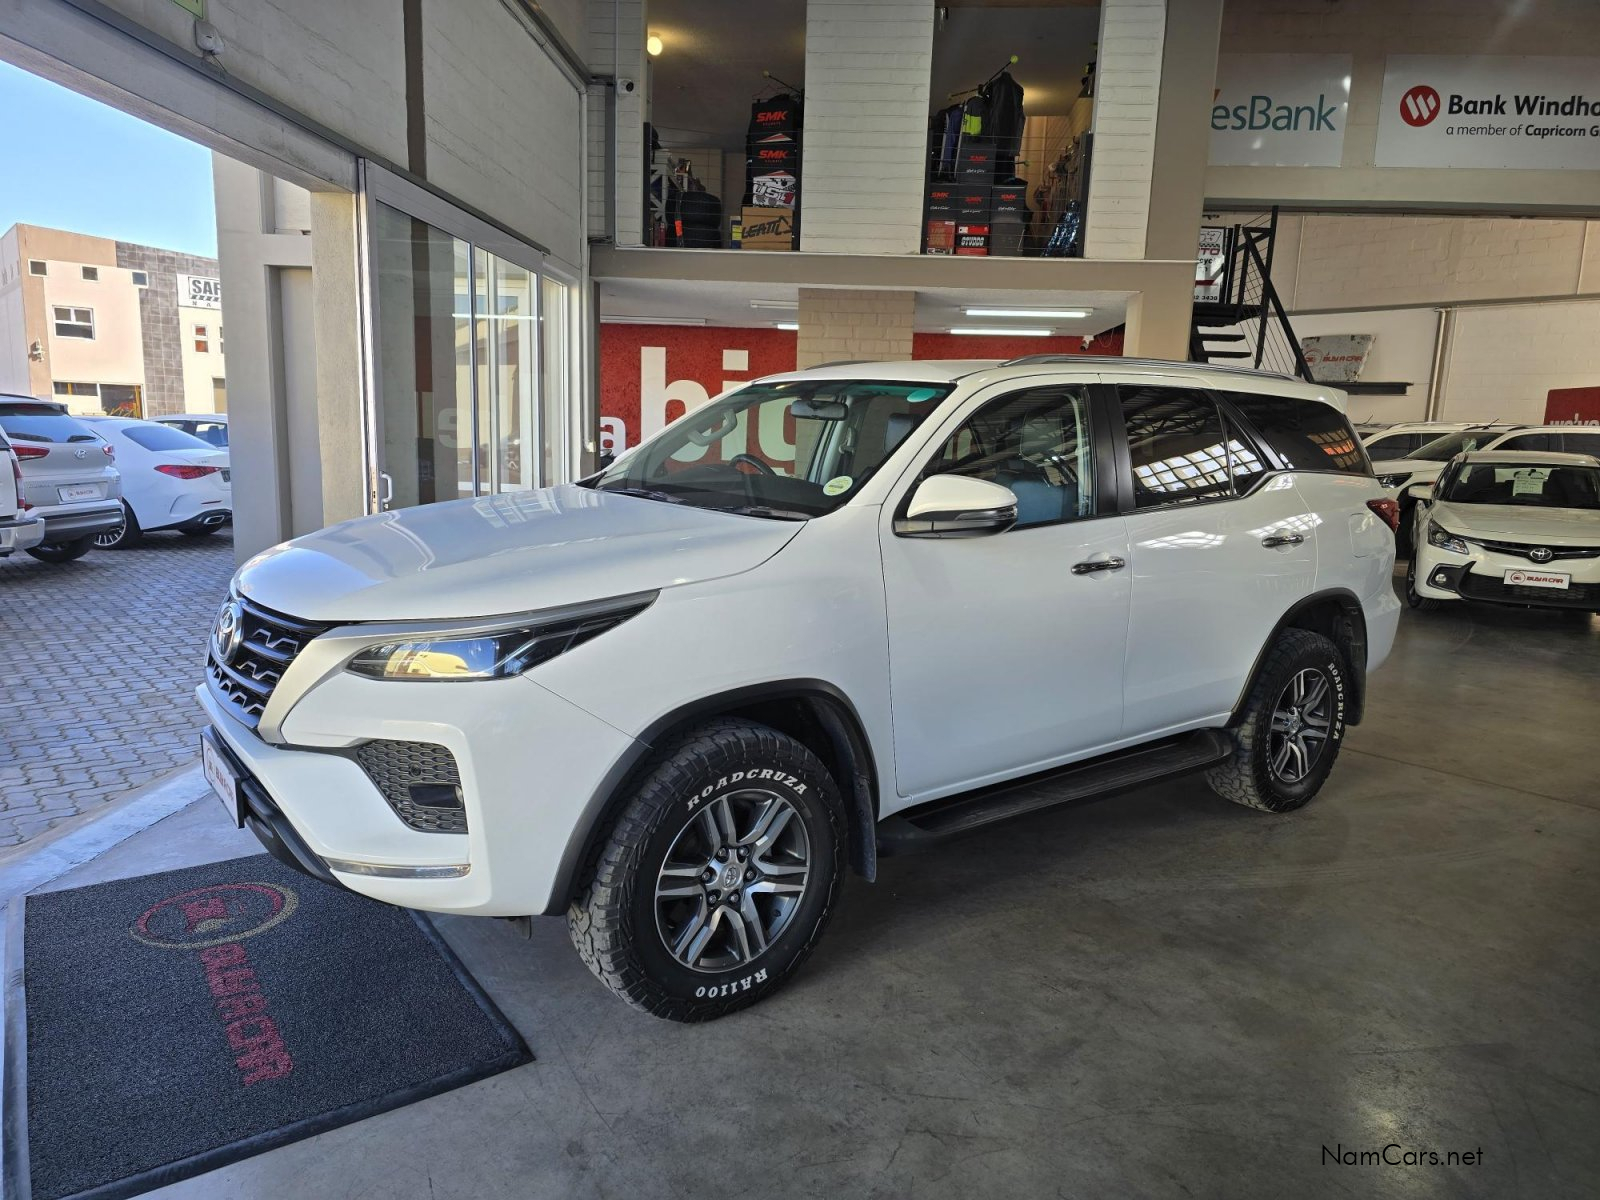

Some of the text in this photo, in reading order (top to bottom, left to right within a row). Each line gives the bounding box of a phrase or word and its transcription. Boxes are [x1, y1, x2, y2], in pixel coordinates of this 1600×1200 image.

[1211, 92, 1337, 131] esBank
[1448, 94, 1600, 116] Bank Windho
[756, 111, 788, 122] SMK
[1446, 124, 1600, 139] a member of Capricorn G
[758, 149, 789, 159] SMK
[1199, 247, 1220, 256] TO
[1327, 662, 1344, 740] ROADCRUZA
[687, 768, 808, 812] ROADCRUZA
[695, 968, 768, 998] RA1100
